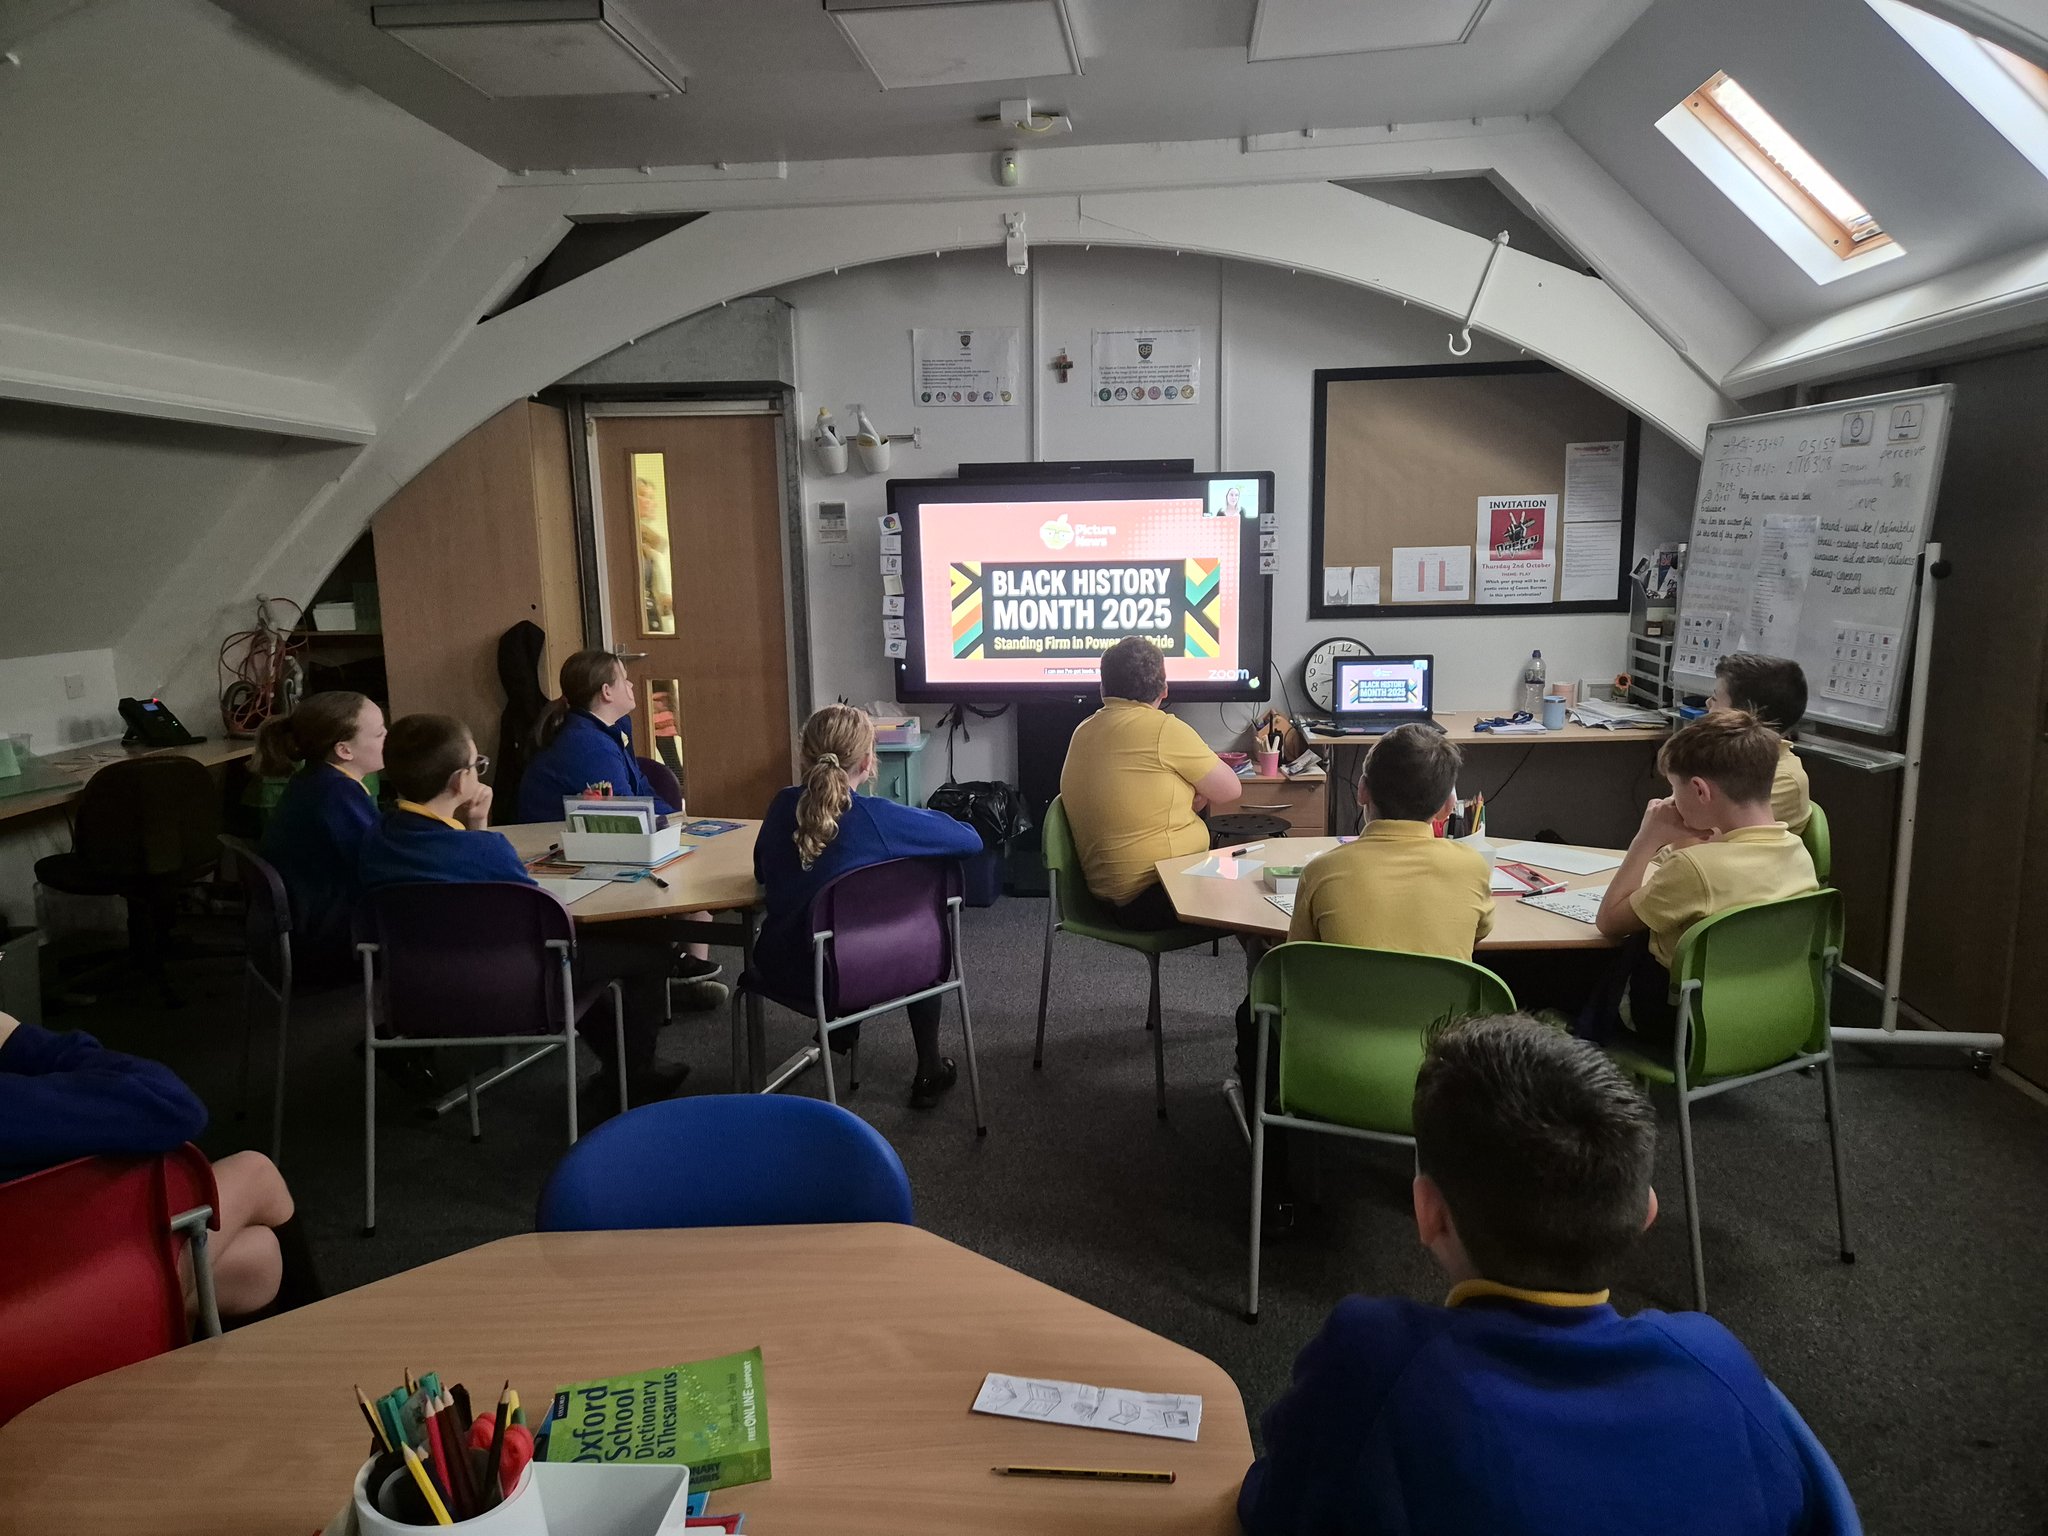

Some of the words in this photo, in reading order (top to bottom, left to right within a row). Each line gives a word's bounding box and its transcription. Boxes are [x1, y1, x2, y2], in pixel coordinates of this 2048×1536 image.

[1490, 500, 1547, 509] INVITATION
[1075, 524, 1117, 536] Picture
[1075, 536, 1108, 547] News
[1482, 563, 1511, 571] Thursday
[991, 569, 1067, 597] BLACK
[1072, 567, 1171, 596] HISTORY
[992, 598, 1095, 631] MONTH
[1101, 598, 1172, 630] 2025
[994, 635, 1044, 652] Standing
[1045, 635, 1071, 649] Firm
[1072, 635, 1081, 649] in
[1341, 643, 1352, 653] 12
[1327, 645, 1336, 655] 11
[1313, 654, 1324, 664] 10
[1208, 669, 1249, 680] zoom
[1308, 668, 1316, 678] 9
[1310, 682, 1318, 692] 8
[1380, 680, 1406, 688] HISTORY
[1360, 688, 1387, 697] MONTH
[1387, 687, 1406, 697] 2025
[1321, 695, 1328, 705] 7
[743, 1360, 753, 1389] SUPPORT
[657, 1372, 677, 1447] Thesaurus
[743, 1388, 757, 1427] ONLINE
[604, 1388, 635, 1461] School
[635, 1381, 661, 1459] Dictionary
[747, 1426, 756, 1441] FREE
